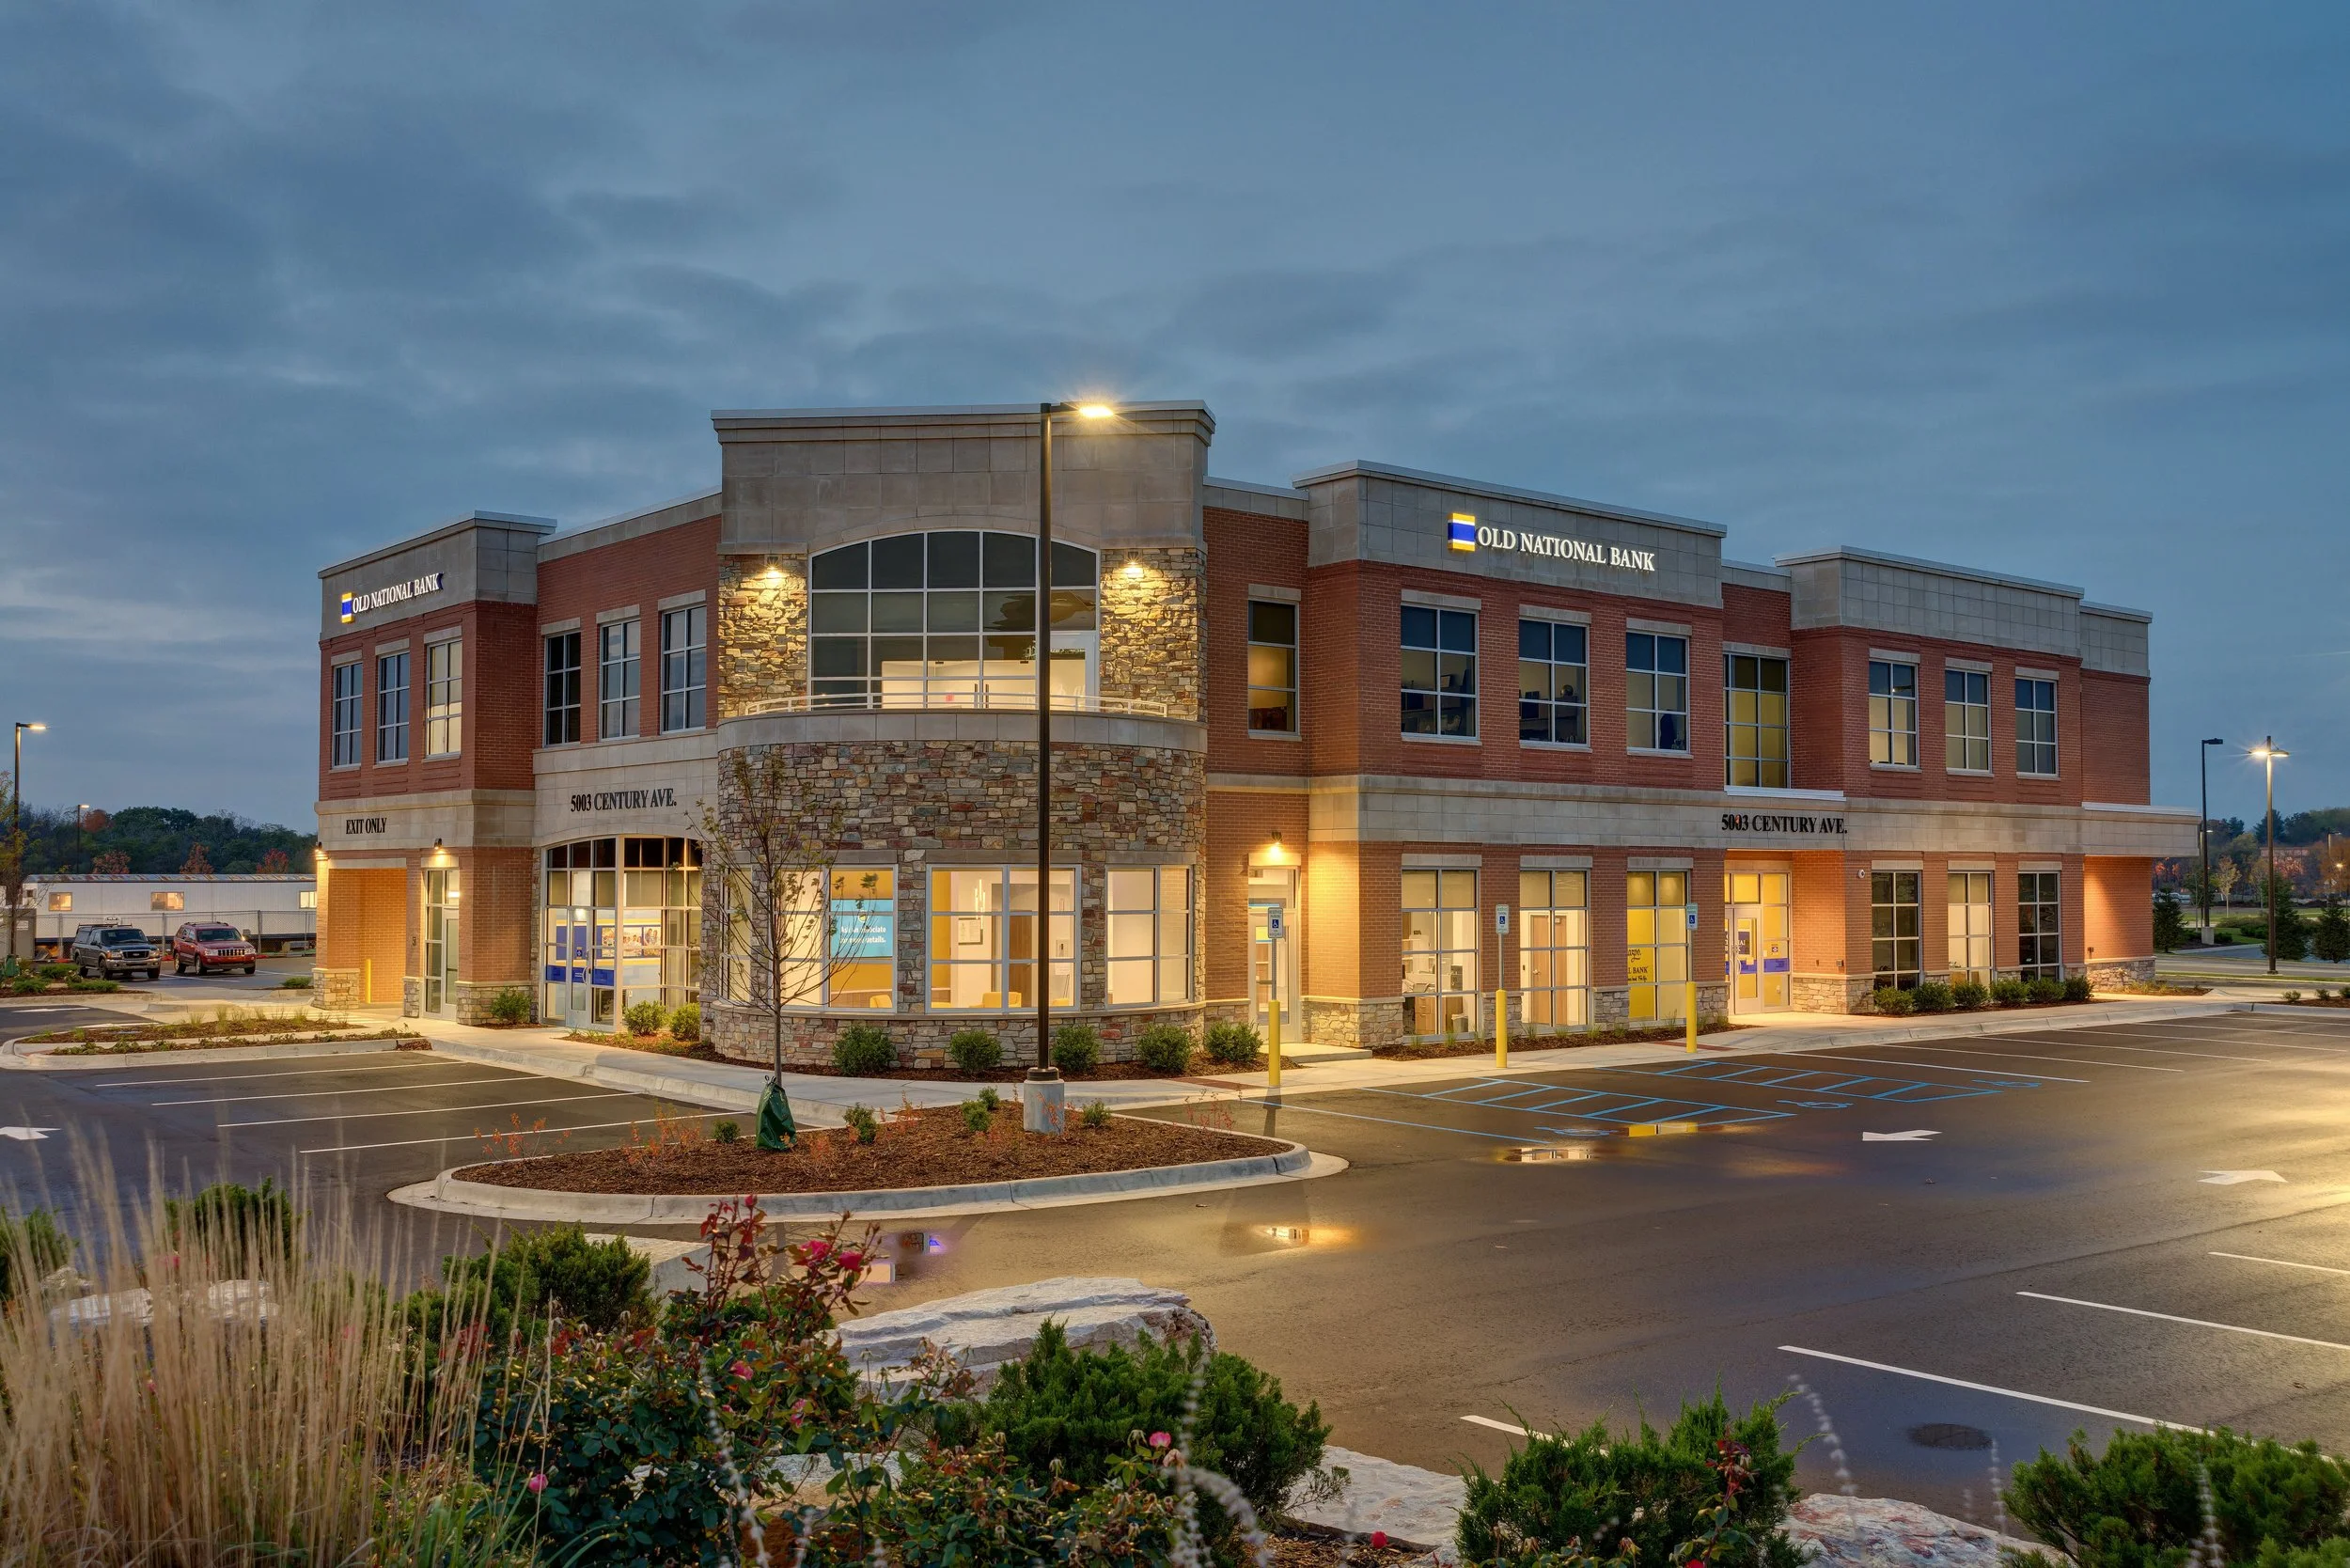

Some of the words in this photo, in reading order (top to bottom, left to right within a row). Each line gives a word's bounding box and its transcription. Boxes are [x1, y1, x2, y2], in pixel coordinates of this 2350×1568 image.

[1478, 526, 1516, 549] OLD
[1520, 532, 1606, 564] NATIONAL
[1609, 547, 1655, 572] BANK
[352, 594, 370, 613] OLD
[370, 581, 413, 608] NATIONAL
[414, 572, 440, 596] BANK
[571, 793, 592, 812] 5003
[593, 790, 649, 810] CENTURY
[650, 788, 678, 808] AVE.
[346, 819, 364, 834] EXIT
[365, 817, 387, 834] ONLY
[1721, 814, 1749, 831] 5003
[1751, 815, 1817, 833] CENTURY
[1819, 818, 1848, 834] AVE.
